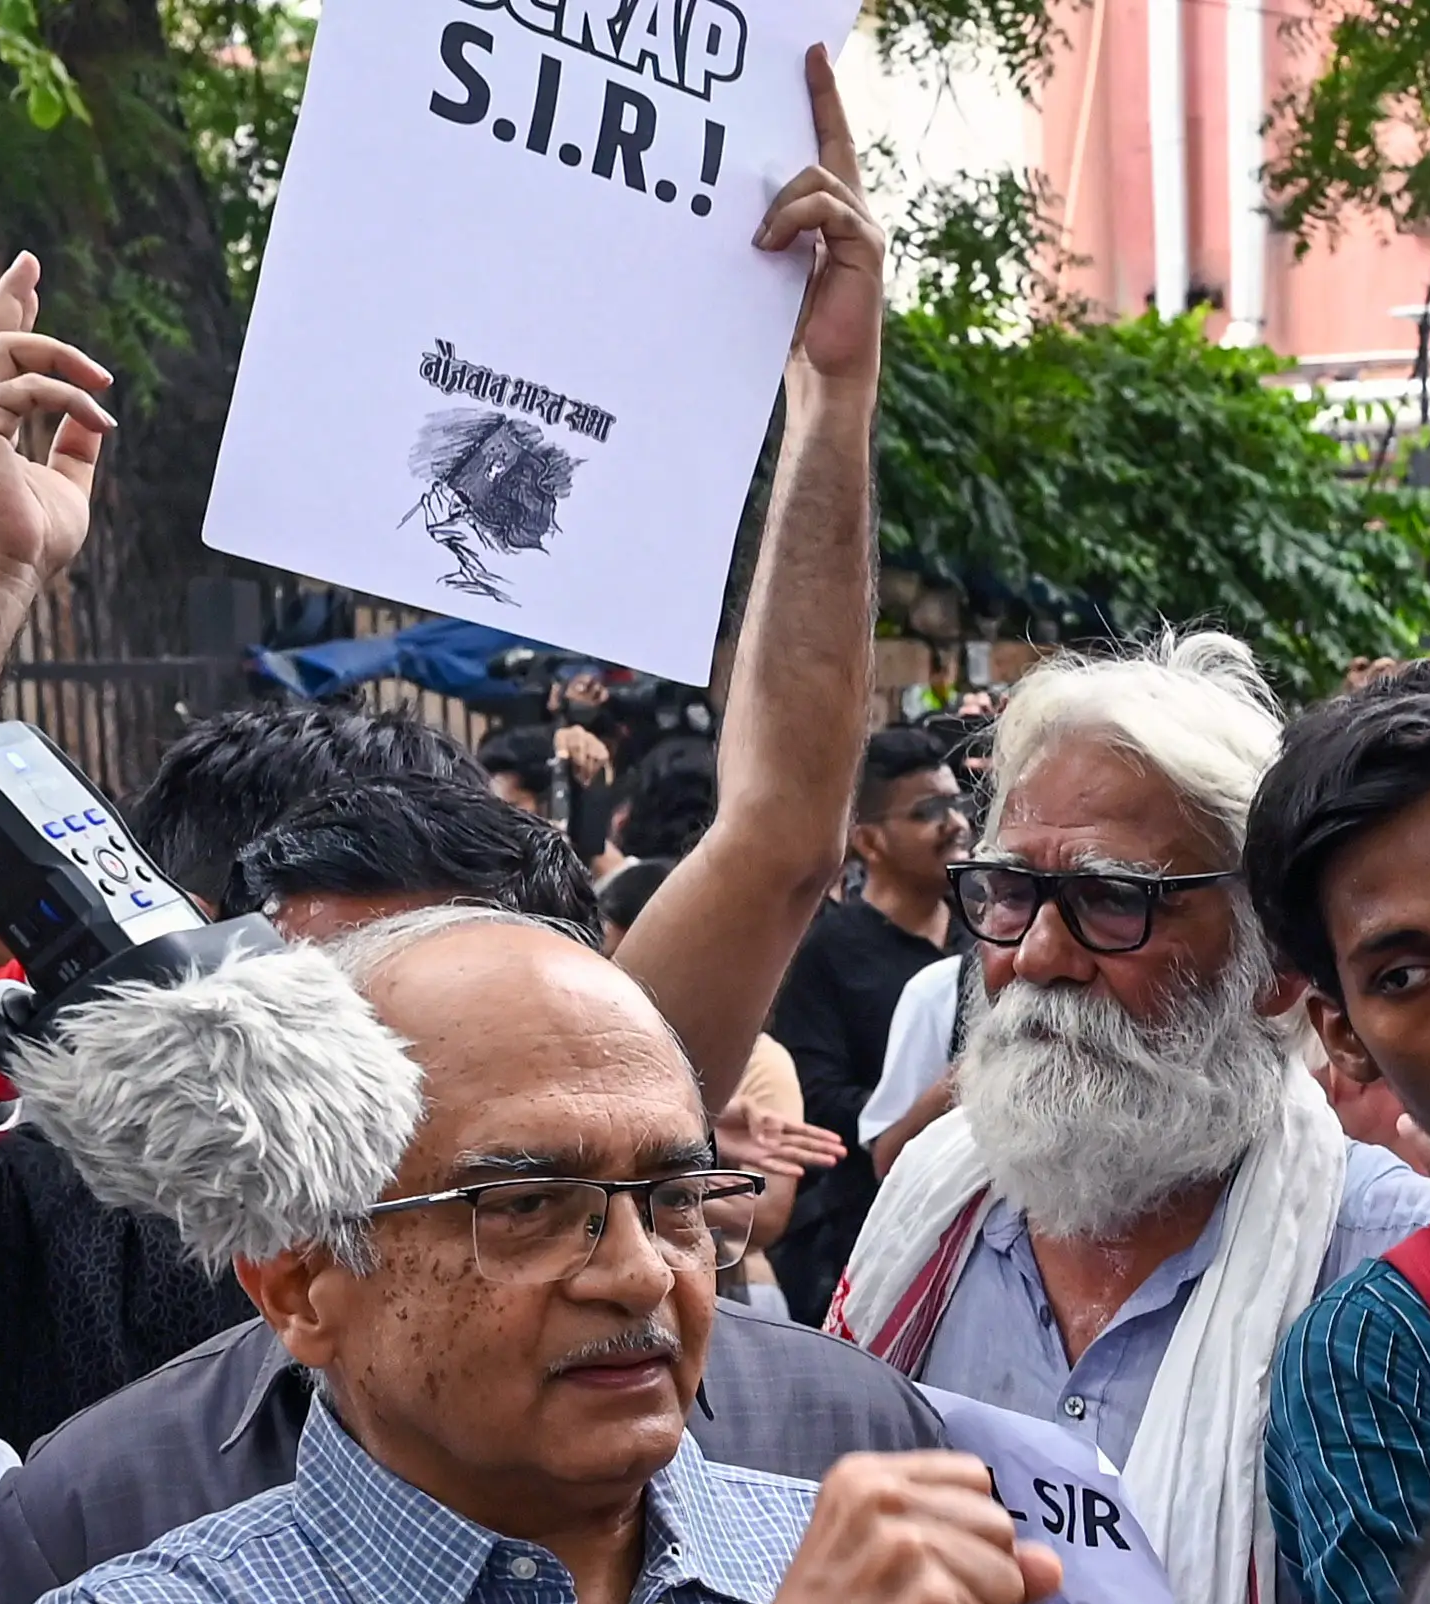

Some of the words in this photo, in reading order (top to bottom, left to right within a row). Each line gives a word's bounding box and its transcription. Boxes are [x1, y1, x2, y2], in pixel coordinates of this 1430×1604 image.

[429, 21, 726, 217] S.I.R.!
[420, 337, 511, 406] नौजवान
[510, 377, 567, 426] भारत
[564, 398, 617, 443] सभा
[1032, 1477, 1132, 1552] SIR
